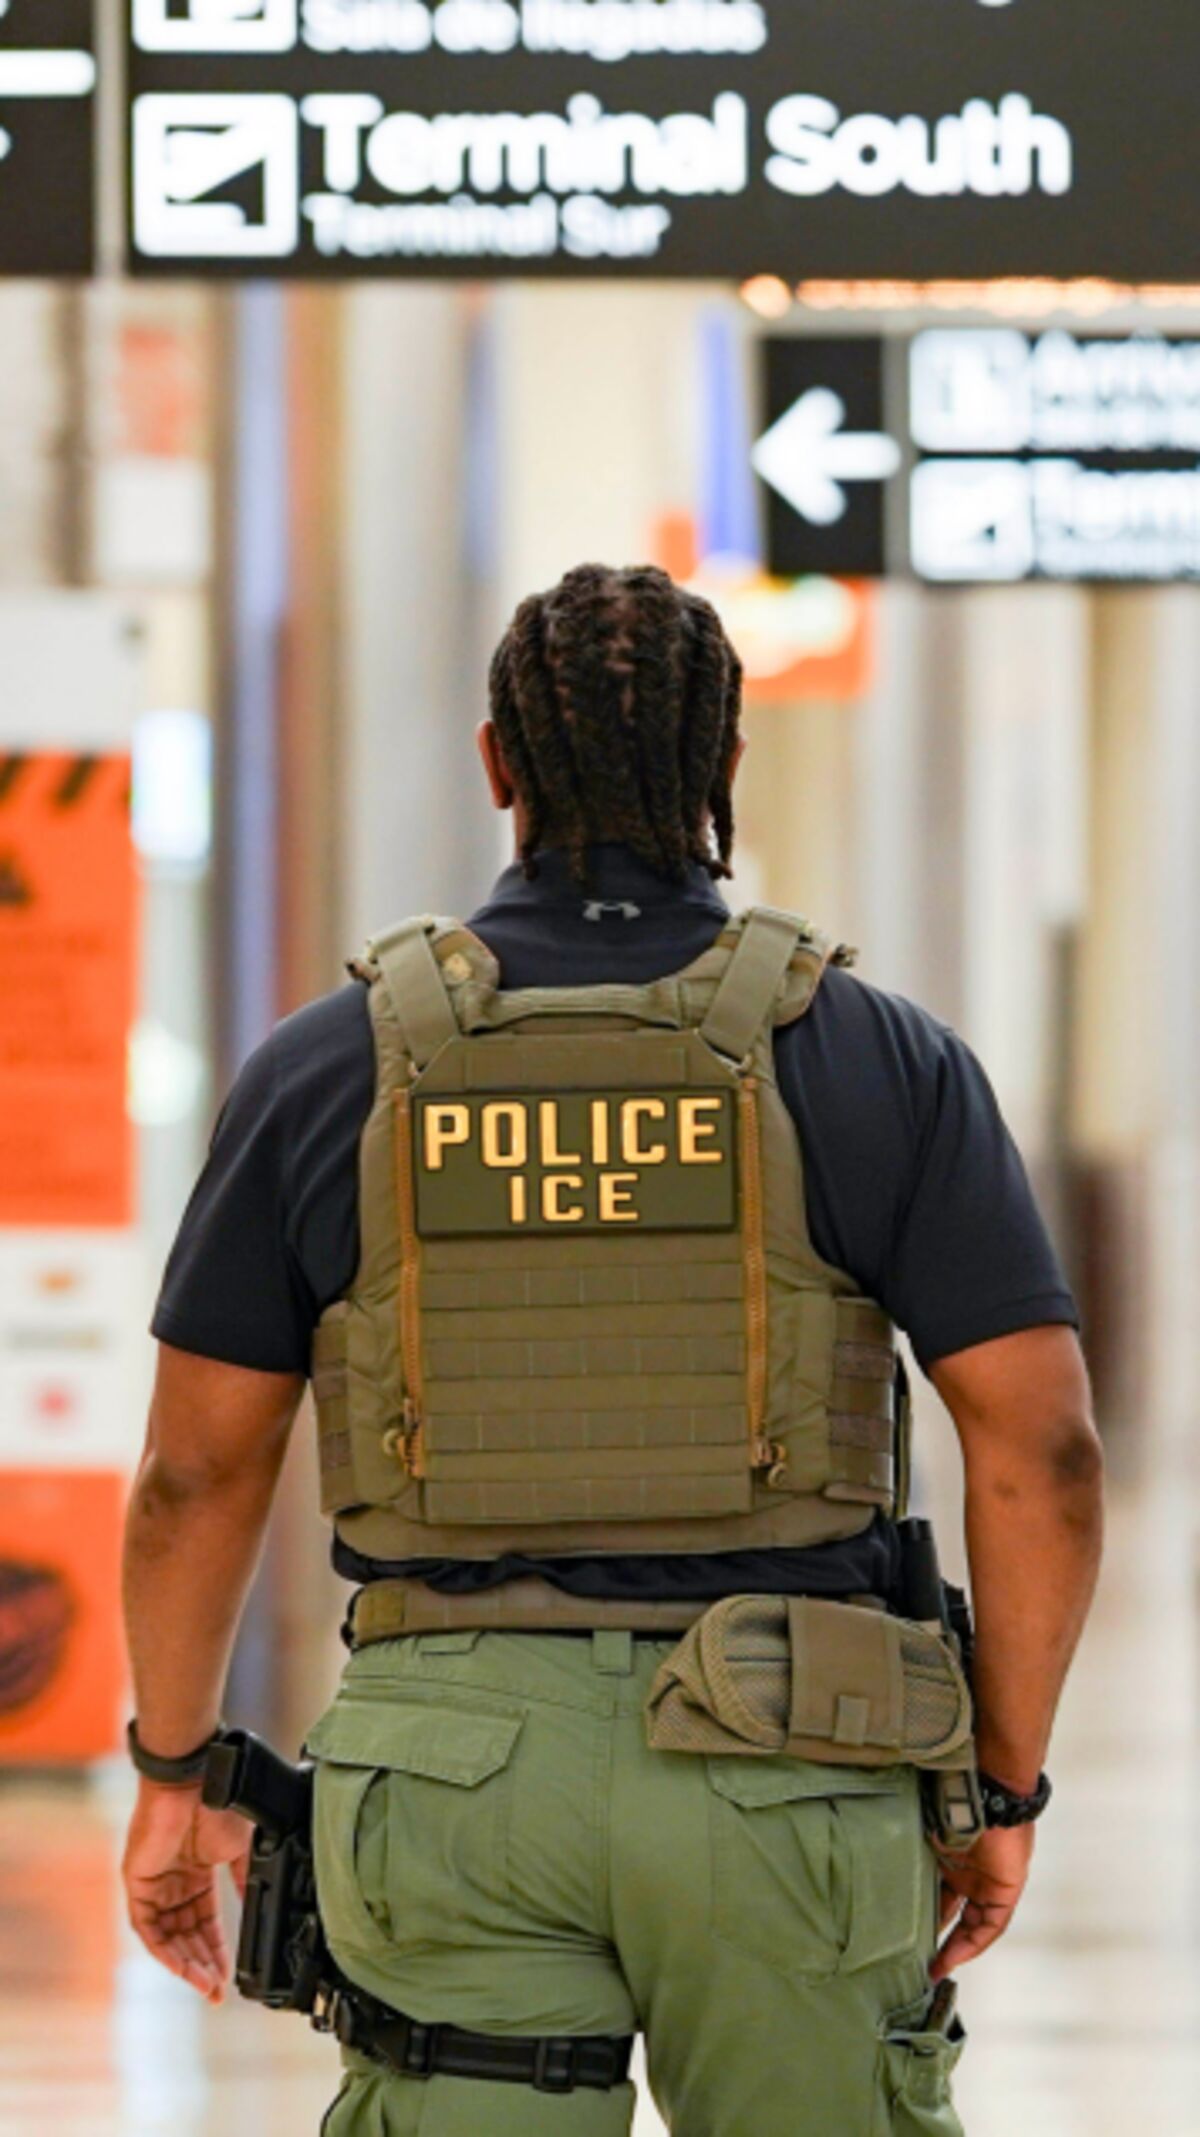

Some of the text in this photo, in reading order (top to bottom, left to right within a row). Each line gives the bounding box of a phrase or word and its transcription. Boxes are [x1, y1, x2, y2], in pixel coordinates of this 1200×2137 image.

[301, 92, 1072, 196] Terminal South
[560, 193, 671, 257] Sur
[424, 1098, 723, 1170] POLICE
[510, 1172, 639, 1223] ICE
